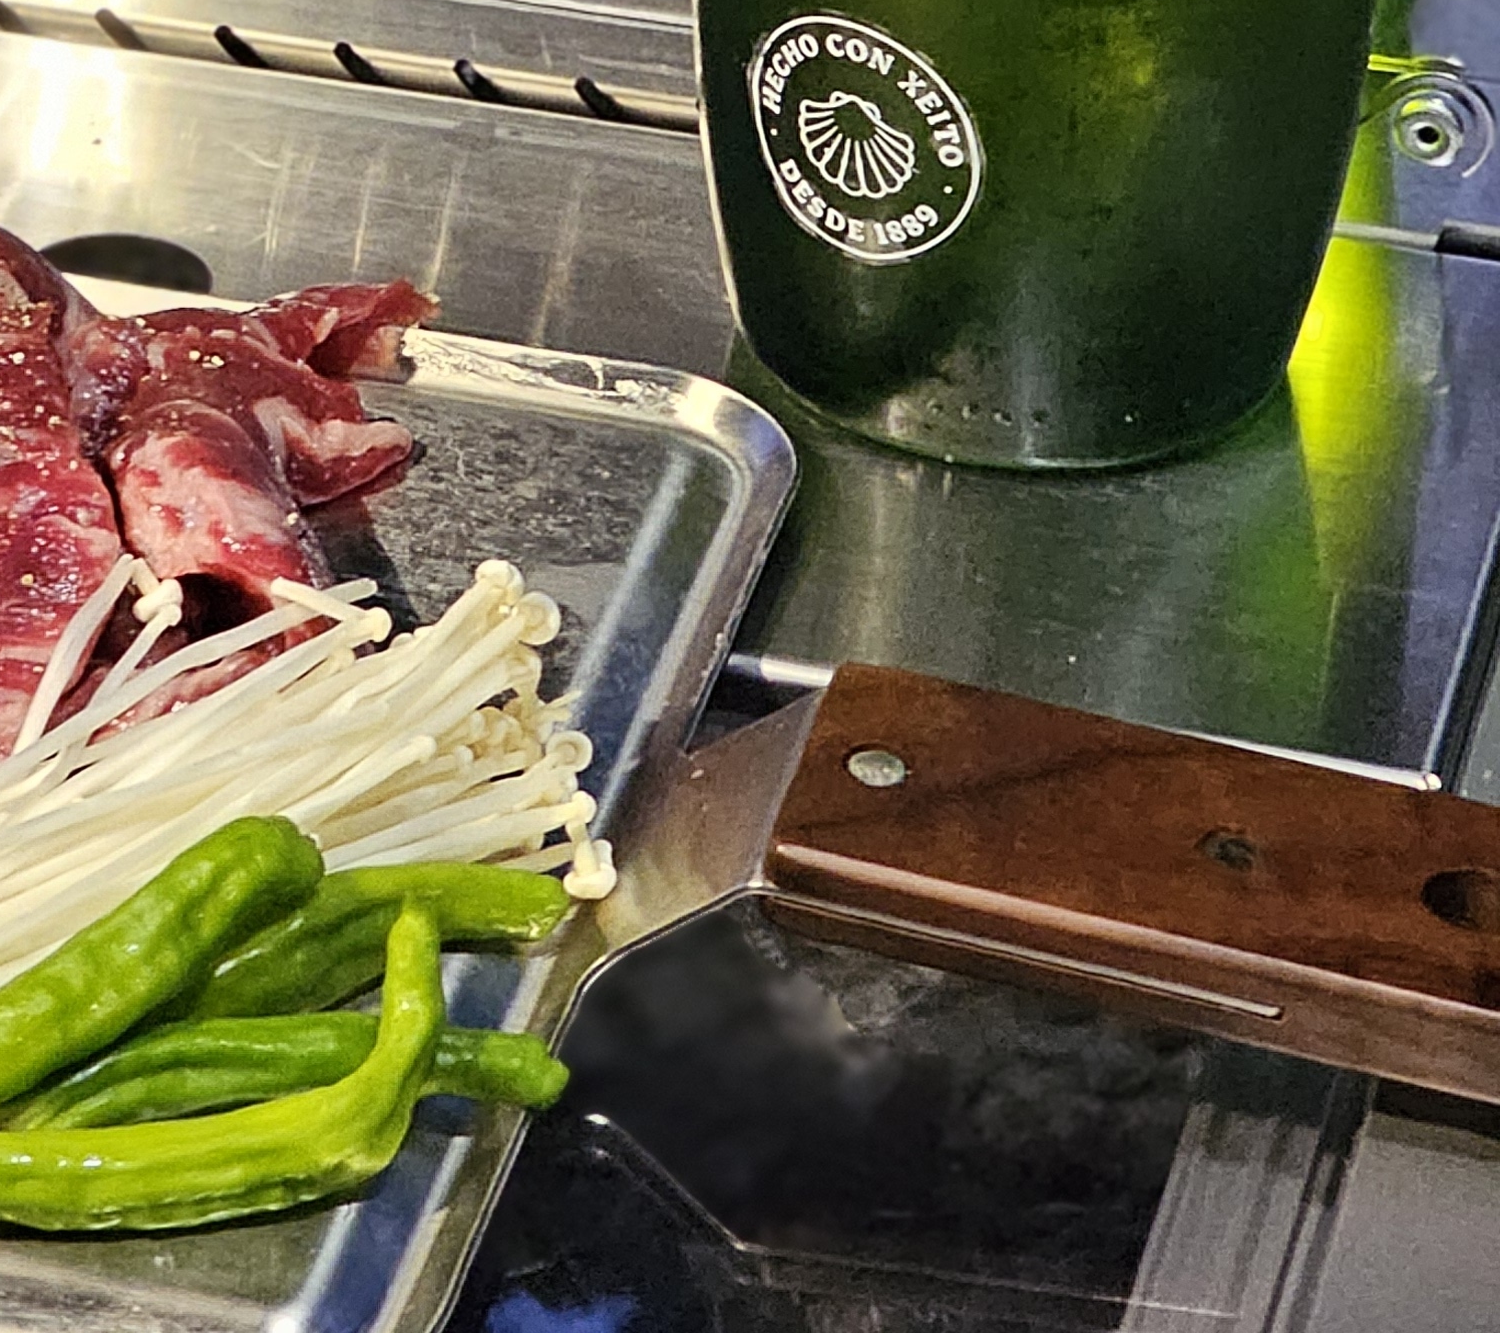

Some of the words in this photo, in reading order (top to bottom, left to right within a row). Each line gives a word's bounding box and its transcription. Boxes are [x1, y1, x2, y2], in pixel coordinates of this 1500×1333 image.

[762, 33, 820, 116] HECHO
[825, 32, 896, 76] CON
[896, 69, 965, 168] XEITO
[779, 158, 865, 243] DESDE
[873, 203, 939, 246] 1889
